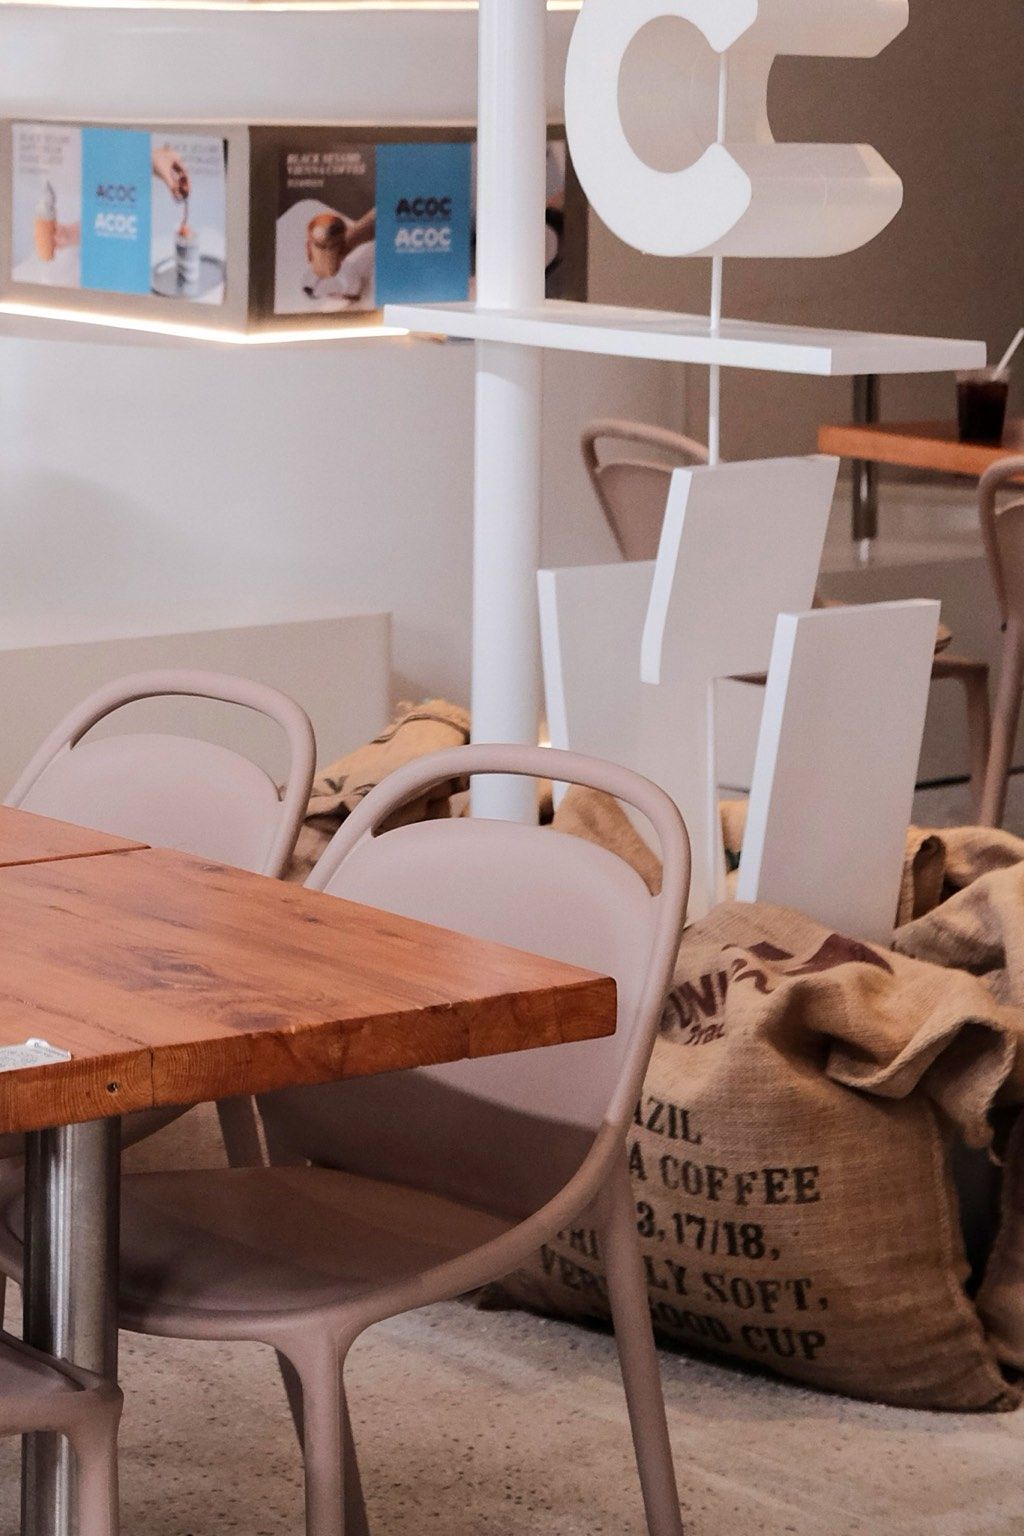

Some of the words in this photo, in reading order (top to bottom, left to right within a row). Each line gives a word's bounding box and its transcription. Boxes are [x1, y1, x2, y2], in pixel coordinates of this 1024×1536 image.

[95, 184, 137, 202] ACOC
[395, 197, 452, 217] ACOC
[93, 213, 138, 234] ACOC
[394, 227, 452, 248] ACOC
[659, 1154, 821, 1207] COFFEE
[702, 1270, 829, 1315] SOFT,
[740, 1323, 827, 1361] CUP
